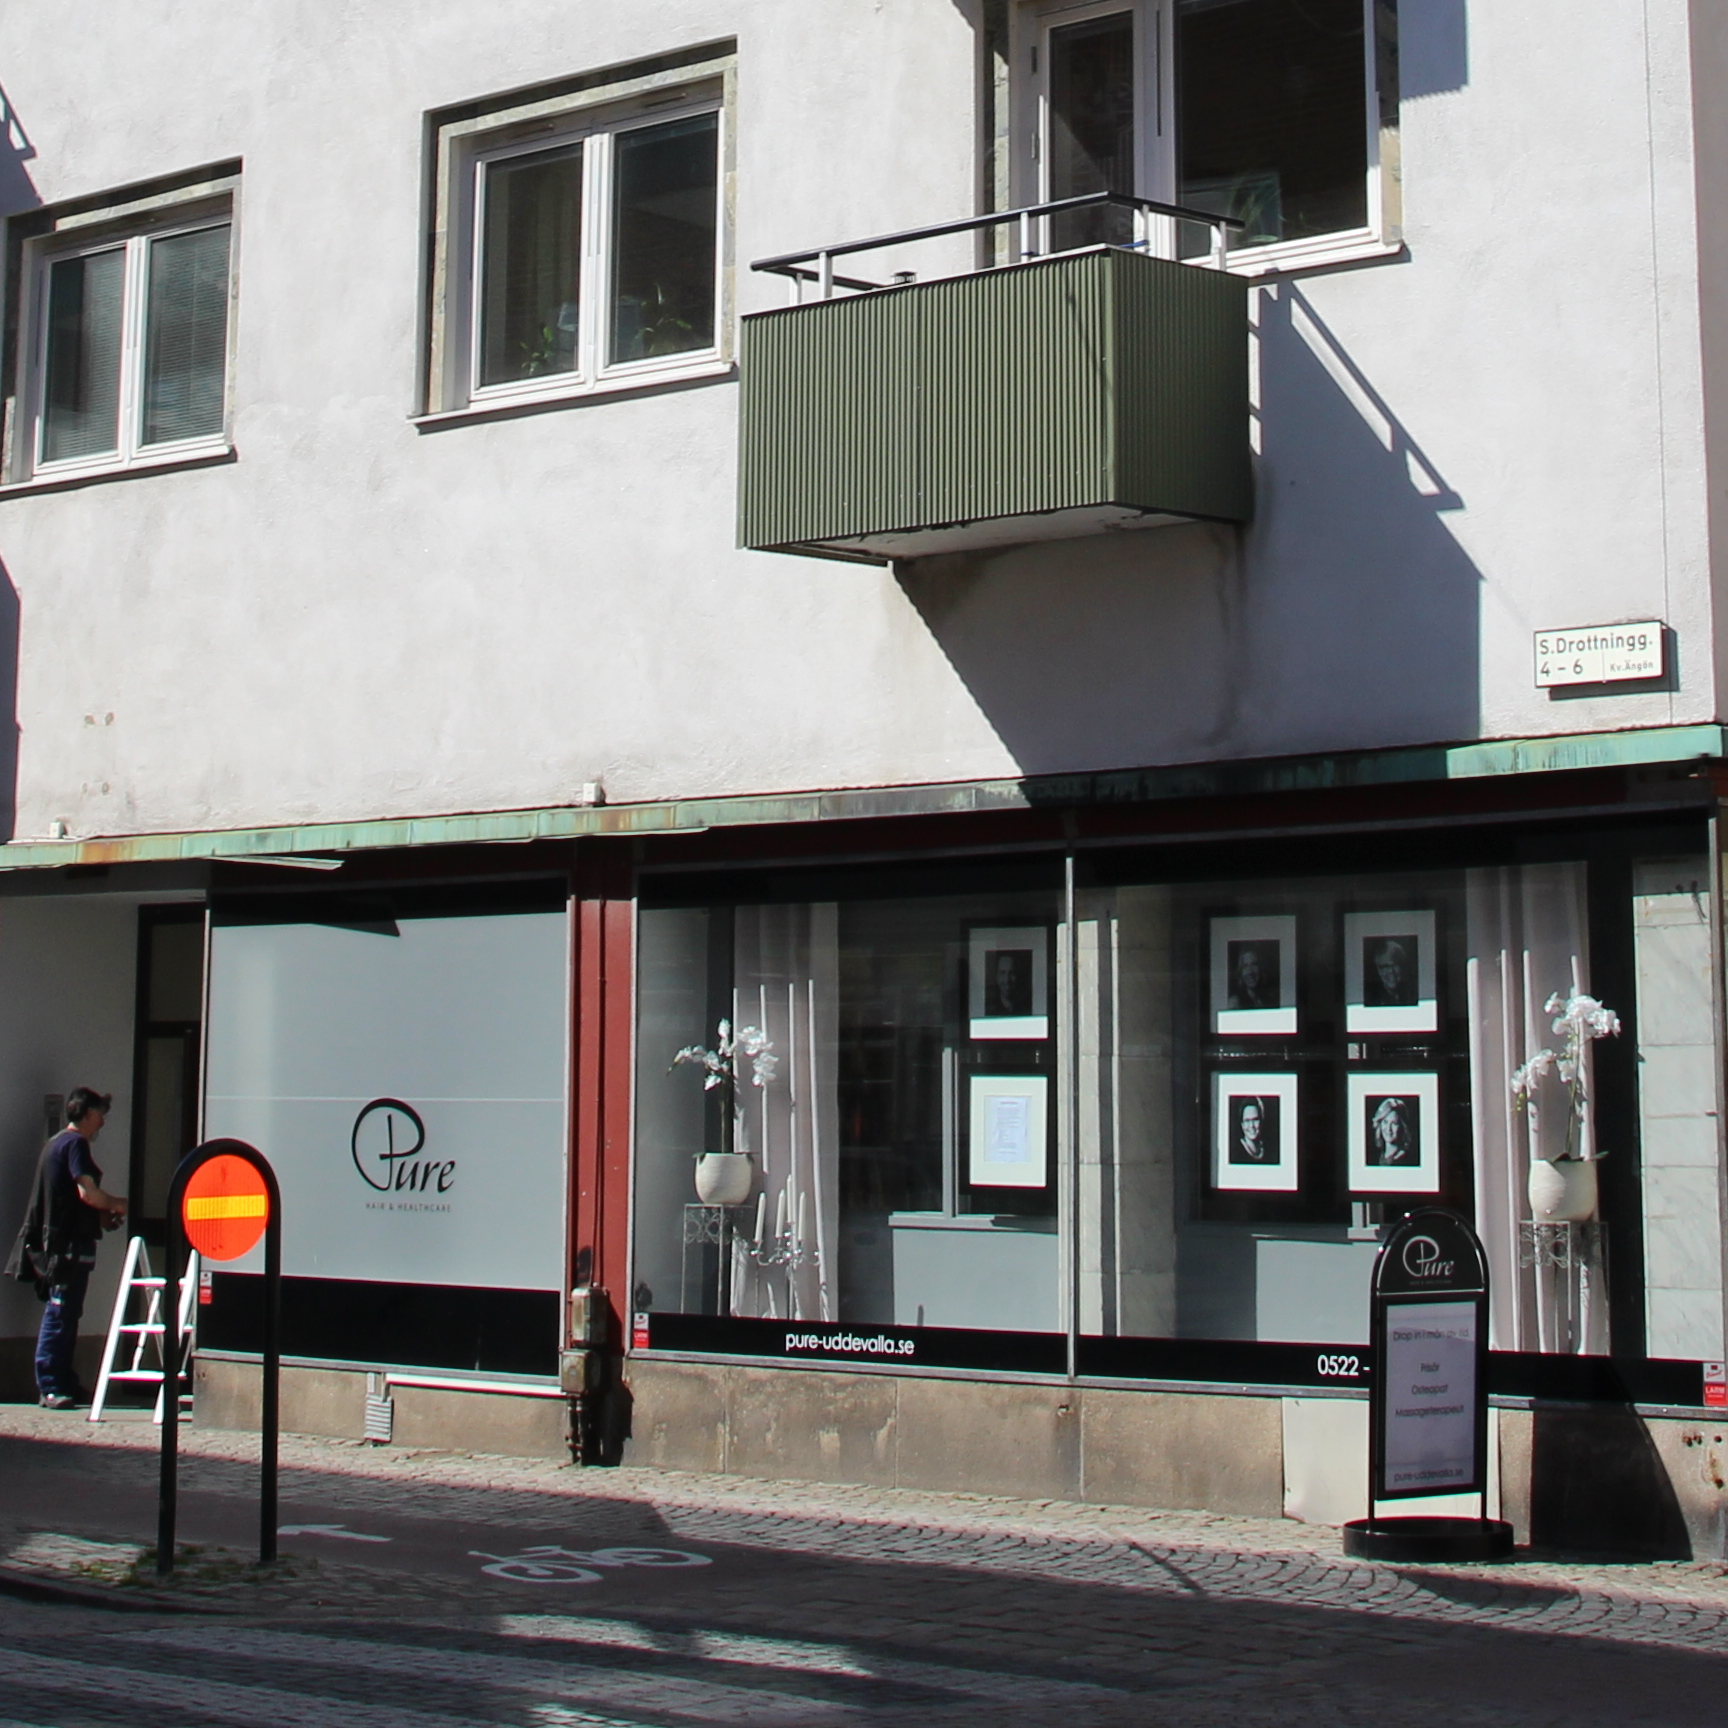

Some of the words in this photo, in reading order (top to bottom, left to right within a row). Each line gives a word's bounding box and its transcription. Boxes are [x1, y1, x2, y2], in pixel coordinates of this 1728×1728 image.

[1539, 660, 1551, 677] 4
[1572, 658, 1584, 675] 6
[351, 1097, 456, 1193] Pure
[397, 1203, 451, 1213] HEALTHCARE
[1402, 1235, 1455, 1278] Pure
[785, 1332, 915, 1354] pure-uddevalla.se
[1393, 1330, 1413, 1341] Drop
[1317, 1354, 1359, 1376] 0522
